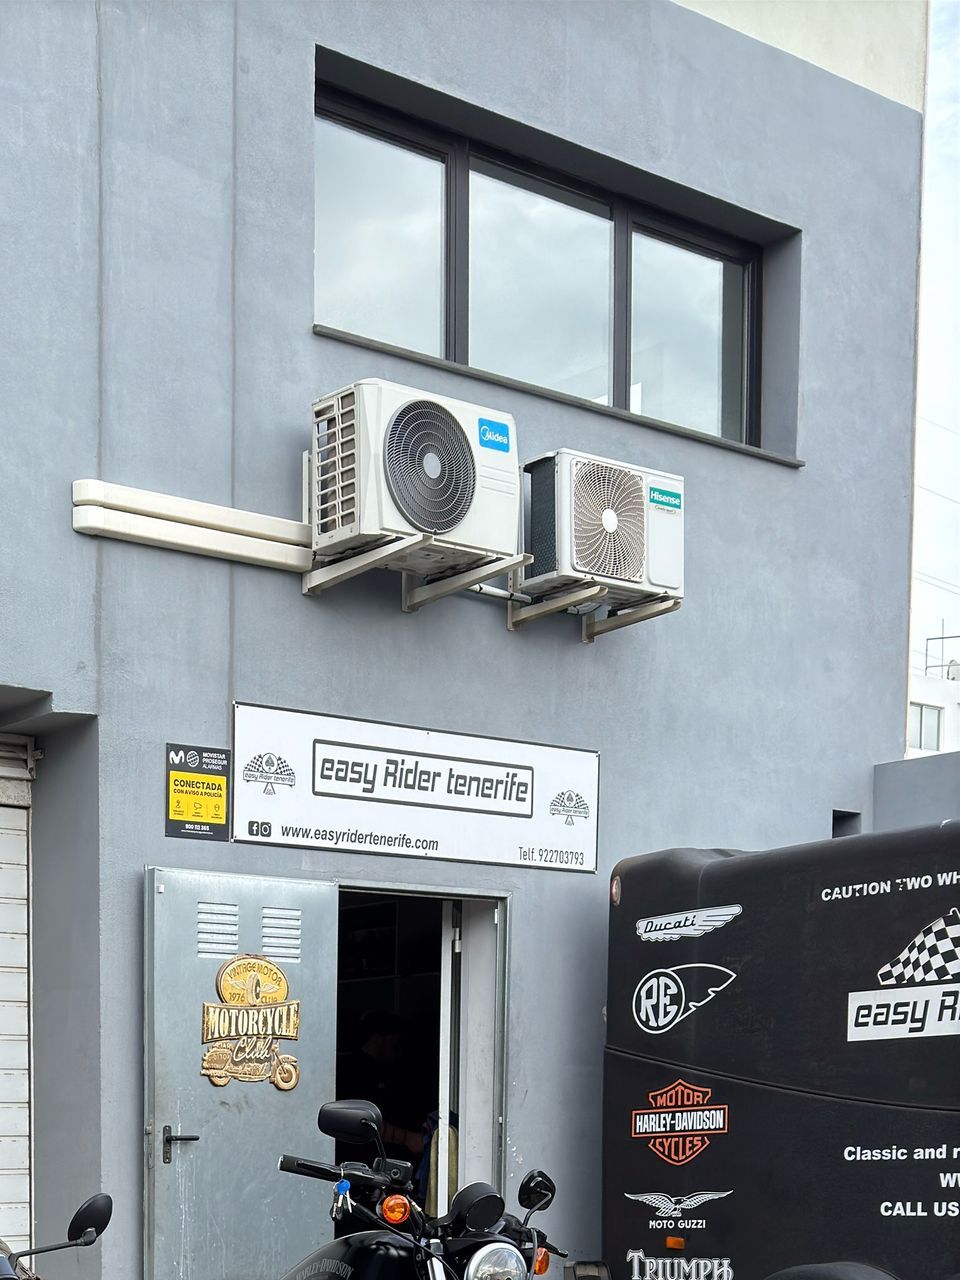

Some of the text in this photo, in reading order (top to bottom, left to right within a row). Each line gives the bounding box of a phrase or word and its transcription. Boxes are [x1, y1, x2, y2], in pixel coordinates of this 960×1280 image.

[650, 490, 680, 505] Hisense
[202, 751, 226, 759] MOVISTAR
[202, 757, 228, 766] PROSEGUR
[173, 778, 223, 792] CONECTADA
[320, 757, 529, 802] easy Rider tenerife
[281, 824, 439, 851] www.easyridertenerife.com
[518, 846, 585, 866] Telf. 922703793
[821, 880, 891, 901] CAUTION
[643, 914, 697, 933] Ducati
[228, 992, 246, 1002] 1976
[207, 1004, 299, 1039] MOTORCYCLE
[854, 990, 960, 1033] easy R
[233, 1036, 274, 1062] Club
[656, 1085, 703, 1107] MOTOR
[636, 1109, 724, 1133] HARLEY-DAVIDSON
[655, 1136, 702, 1161] CYCLES
[843, 1145, 908, 1161] Classic
[913, 1144, 947, 1160] and
[880, 1201, 960, 1217] CALL US
[648, 1219, 706, 1229] MOTO GUZZI
